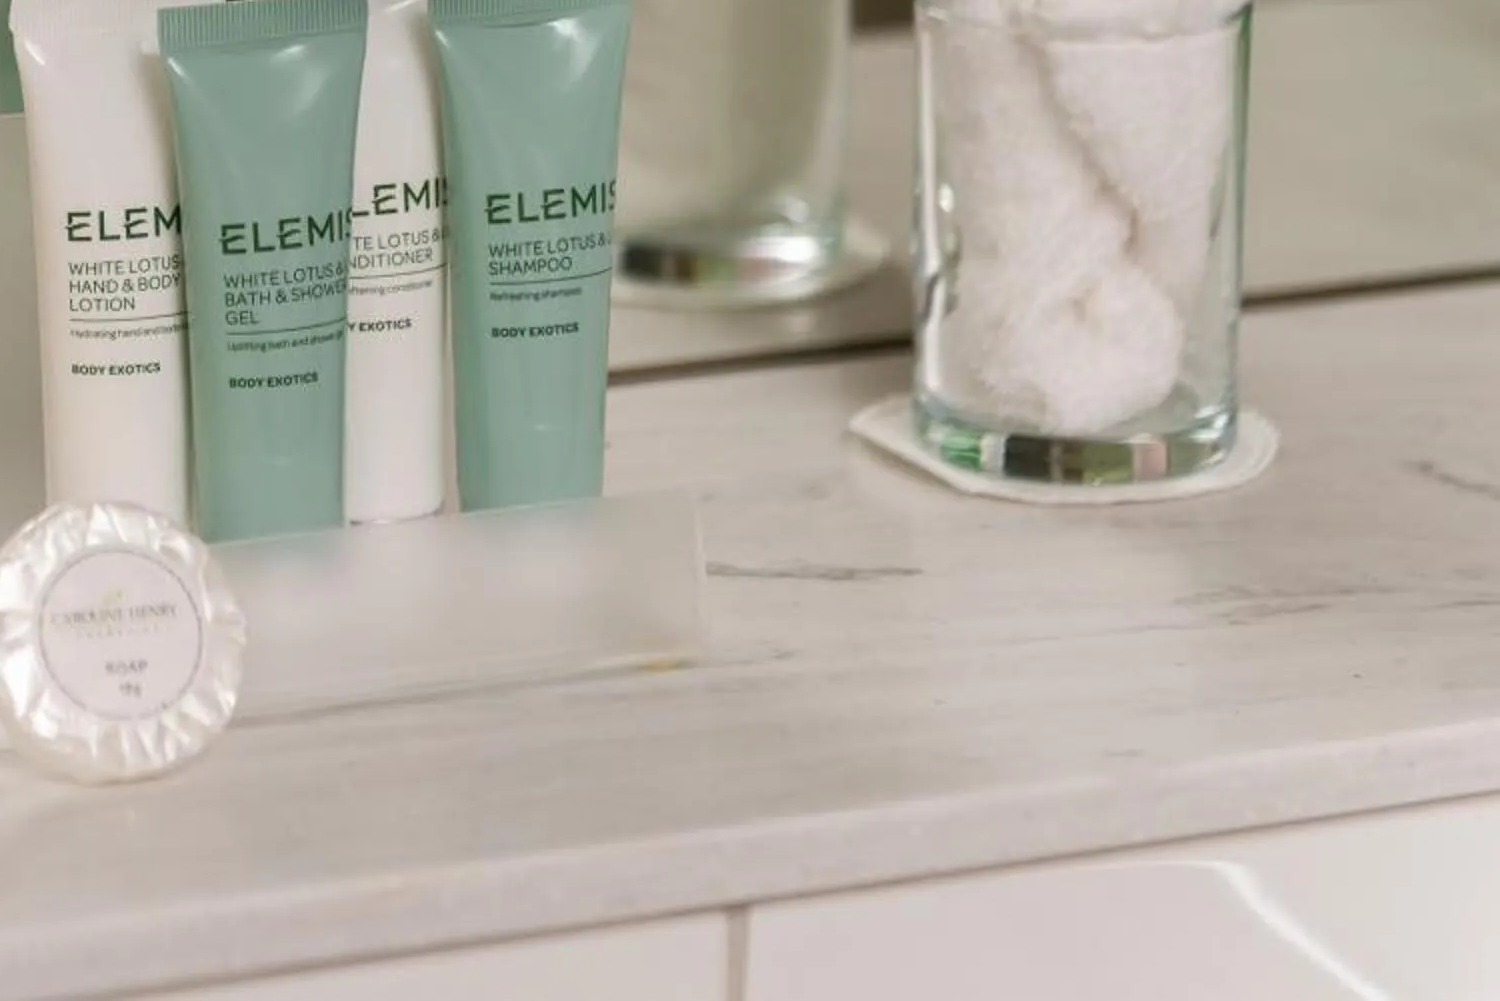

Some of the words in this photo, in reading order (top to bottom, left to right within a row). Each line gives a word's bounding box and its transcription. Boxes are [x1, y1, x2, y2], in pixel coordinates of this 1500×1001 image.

[65, 204, 181, 241] ELEM
[378, 230, 428, 249] LOTUS
[488, 241, 543, 258] WHITE
[547, 234, 597, 254] LOTUS
[68, 261, 124, 275] WHITE
[129, 254, 180, 274] LOTUS
[350, 247, 433, 269] NDITIONER
[488, 256, 572, 275] SHAMPOO
[70, 279, 118, 294] HAND
[121, 278, 133, 293] &
[138, 273, 181, 291] BODY
[224, 271, 280, 288] WHITE
[284, 263, 333, 284] LOTUS
[69, 297, 136, 312] LOTION
[225, 289, 271, 307] BATH
[275, 288, 287, 304] &
[226, 311, 260, 326] GEL
[359, 318, 412, 332] EXOTICS
[492, 327, 526, 338] BODY
[529, 321, 579, 337] EXOTICS
[72, 364, 106, 375] BODY
[108, 362, 161, 375] EXOTICS
[229, 376, 263, 388] BODY
[266, 371, 319, 387] EXOTICS
